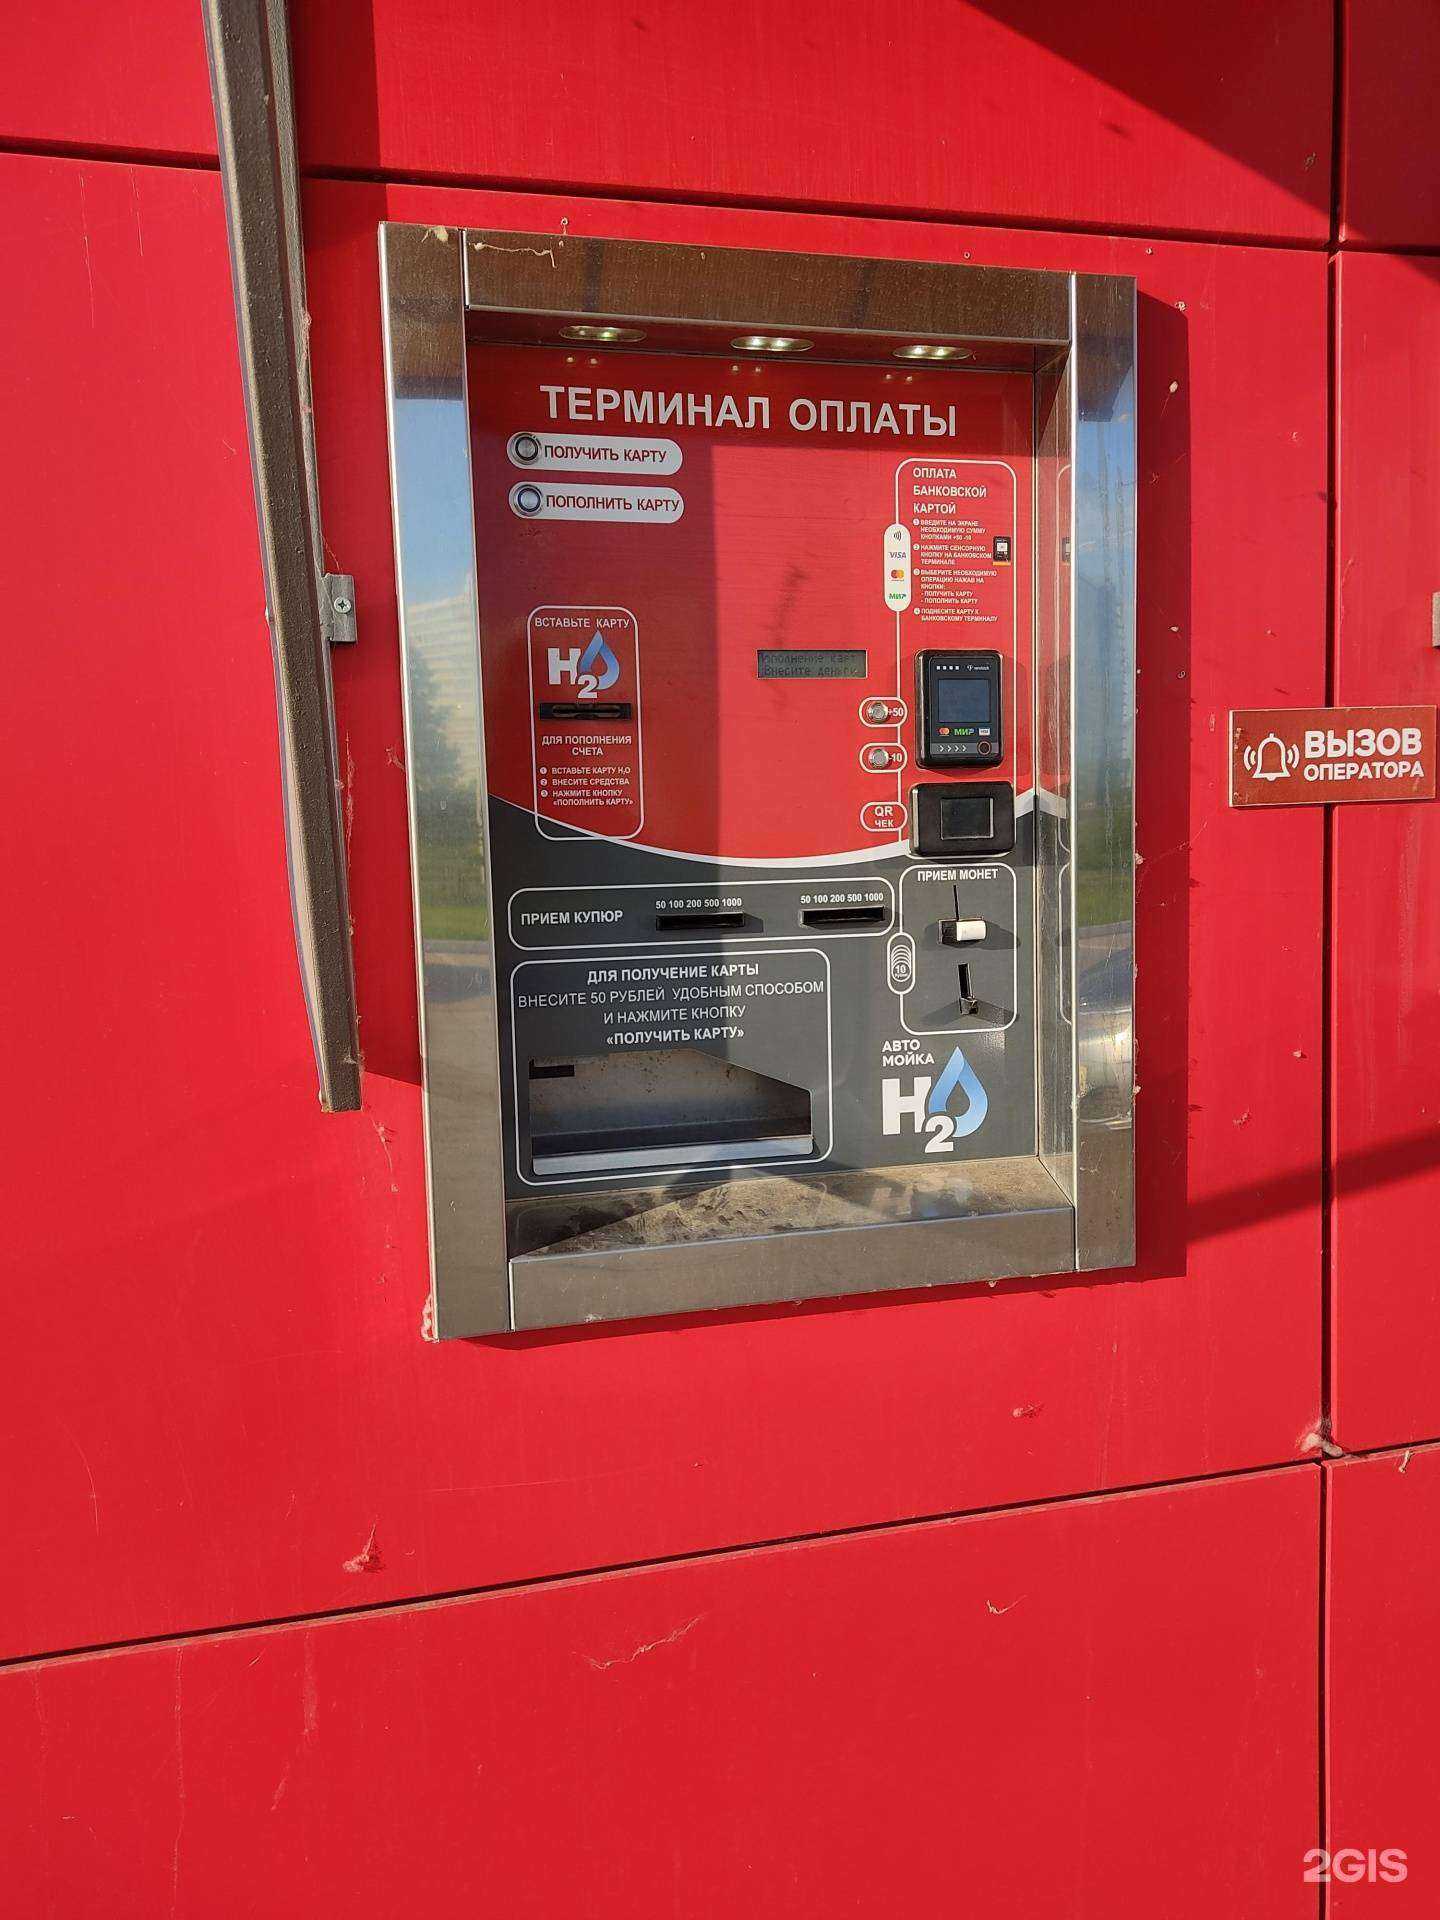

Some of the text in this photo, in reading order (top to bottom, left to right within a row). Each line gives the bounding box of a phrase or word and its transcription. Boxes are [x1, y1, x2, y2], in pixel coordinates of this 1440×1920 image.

[540, 385, 957, 437] ТЕРМИНАЛ ОПЛАТЫ
[544, 444, 667, 464] ПОЛУЧИТЬ КАРТУ
[913, 467, 957, 479] ОПЛАТА
[913, 485, 987, 498] БАНКОВСКОЙ
[545, 494, 680, 514] ПОПОЛНИТЬ КАРТУ
[913, 502, 957, 514] КАРТОЙ
[889, 551, 907, 559] VISA
[535, 617, 630, 629] ВСТАВЬТЕ КАРТУ
[954, 728, 976, 736] МИР
[541, 735, 632, 746] ДЛЯ ПОПОЛНЕНИЯ
[1304, 728, 1422, 758] ВЫЗОВ
[571, 747, 604, 756] СЧЕТА
[551, 767, 591, 775] ВСТАВЬТЕ
[592, 766, 617, 774] КАРТУ
[1303, 760, 1425, 781] ОПЕРАТОРА
[589, 778, 630, 787] СРЕДСТВА
[592, 789, 622, 797] КНОПКУ
[874, 806, 893, 817] QR
[874, 819, 894, 828] ЧЕК
[917, 868, 999, 882] ПРИЕМ МОНЕТ
[655, 897, 742, 909] 50 100 200 500 1000
[800, 892, 884, 904] 50 100 200 500 1000
[521, 910, 623, 926] ПРИЕМ КУПЮР
[587, 963, 759, 984] ДЛЯ ПОЛУЧЕНИЕ КАРТЫ
[894, 964, 906, 974] 10
[518, 981, 824, 1008] ВНЕСИТЕ 50 РУБЛЕЙ УДОБНЫМ СПОСОБОМ
[604, 1005, 746, 1025] И НАЖМИТЕ КНОПКУ
[606, 1027, 745, 1046] «ПОЛУЧИТЬ КАРТУ»
[882, 1039, 921, 1053] АВТО
[882, 1051, 935, 1067] МОЙКА
